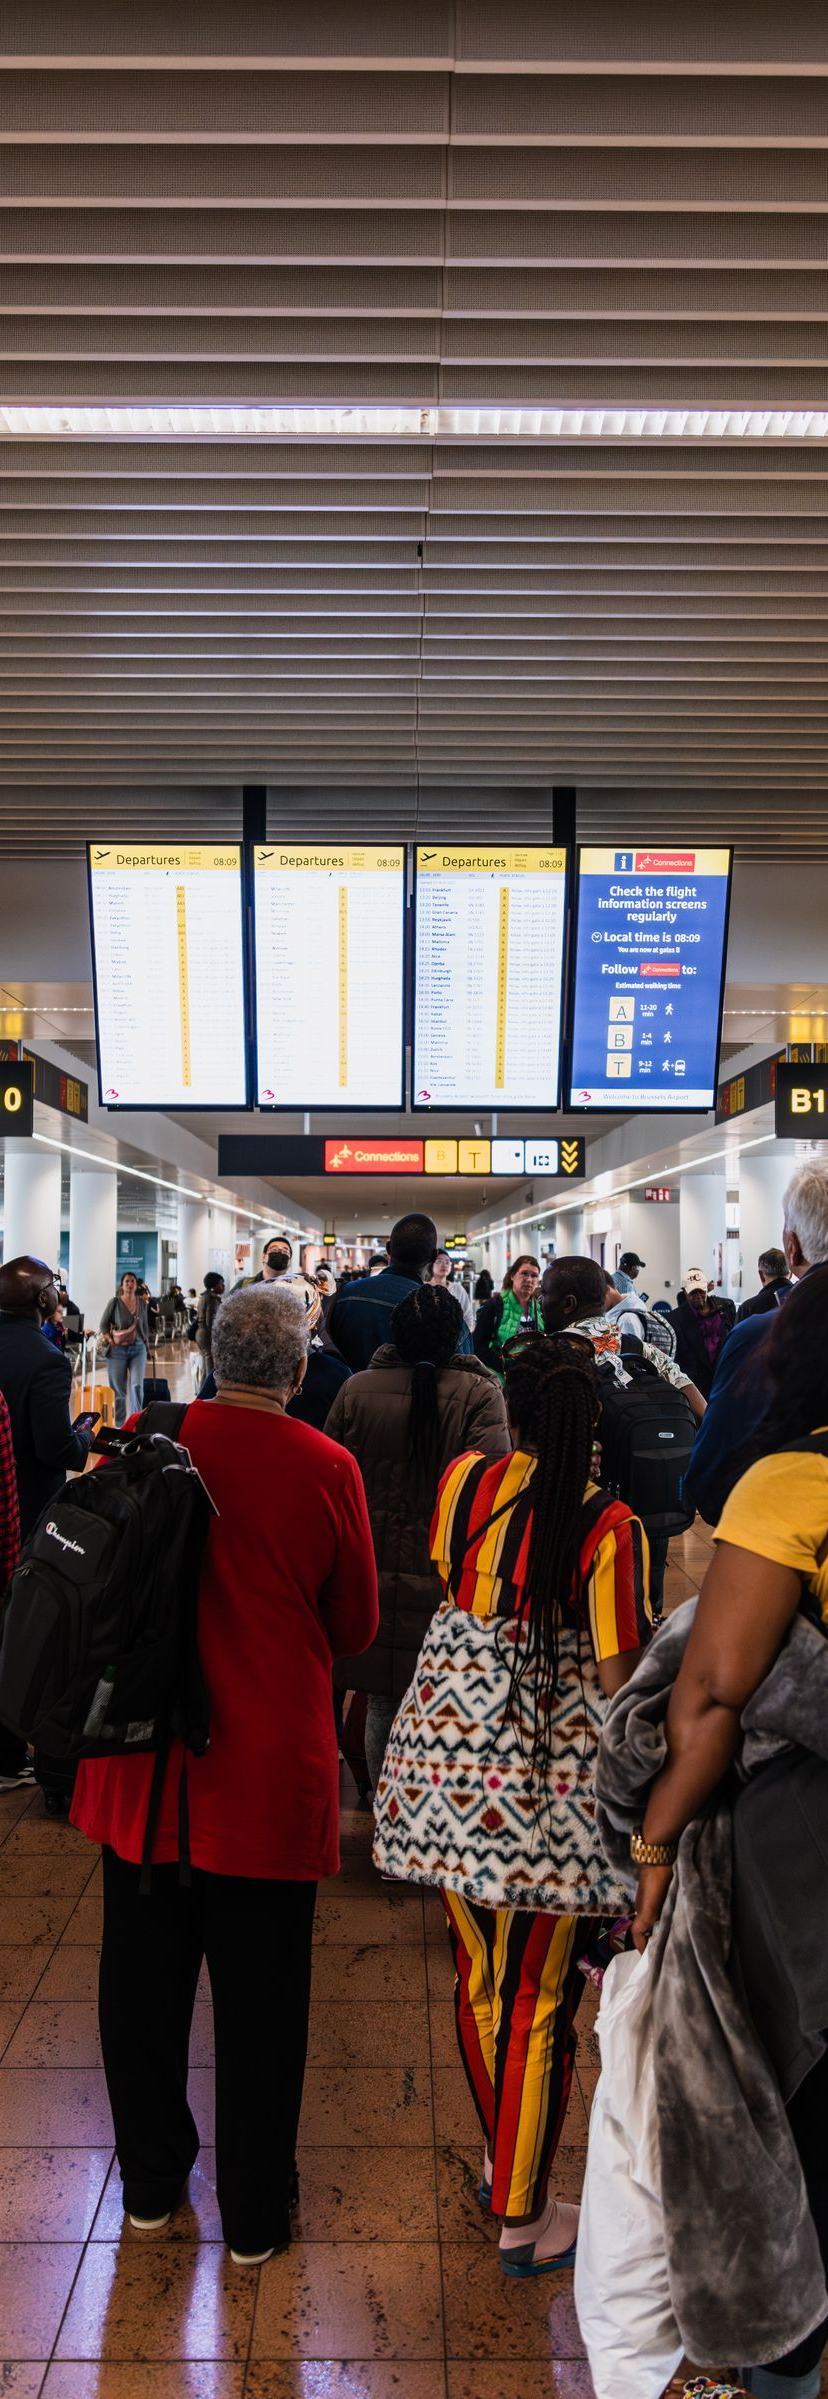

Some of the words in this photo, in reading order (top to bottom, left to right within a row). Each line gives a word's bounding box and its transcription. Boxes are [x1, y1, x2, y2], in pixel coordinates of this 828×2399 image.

[116, 854, 181, 867] Departures
[213, 857, 237, 866] 08:09
[280, 855, 344, 868] Departures
[376, 858, 400, 867] 08:09
[442, 856, 506, 869] Departures
[539, 859, 563, 868] 08:09
[653, 859, 693, 867] Connections
[609, 885, 643, 897] Check
[645, 885, 664, 897] the
[665, 886, 697, 899] flight
[598, 898, 663, 909] information
[665, 900, 707, 910] screens
[626, 911, 677, 924] regularly
[604, 931, 632, 942] Local
[634, 932, 660, 942] time
[662, 932, 672, 942] is
[674, 934, 701, 943] 08:09
[659, 946, 675, 954] gates
[601, 963, 638, 974] Follow
[681, 964, 697, 974] to:
[644, 982, 667, 991] walking
[616, 1006, 627, 1019] A
[614, 1033, 625, 1047] B
[640, 1038, 653, 1046] min
[613, 1061, 624, 1075] T
[4, 1087, 22, 1112] 0
[791, 1088, 825, 1113] B1
[354, 1150, 419, 1163] Connections
[468, 1152, 481, 1168] T
[45, 1521, 85, 1555] Champion
